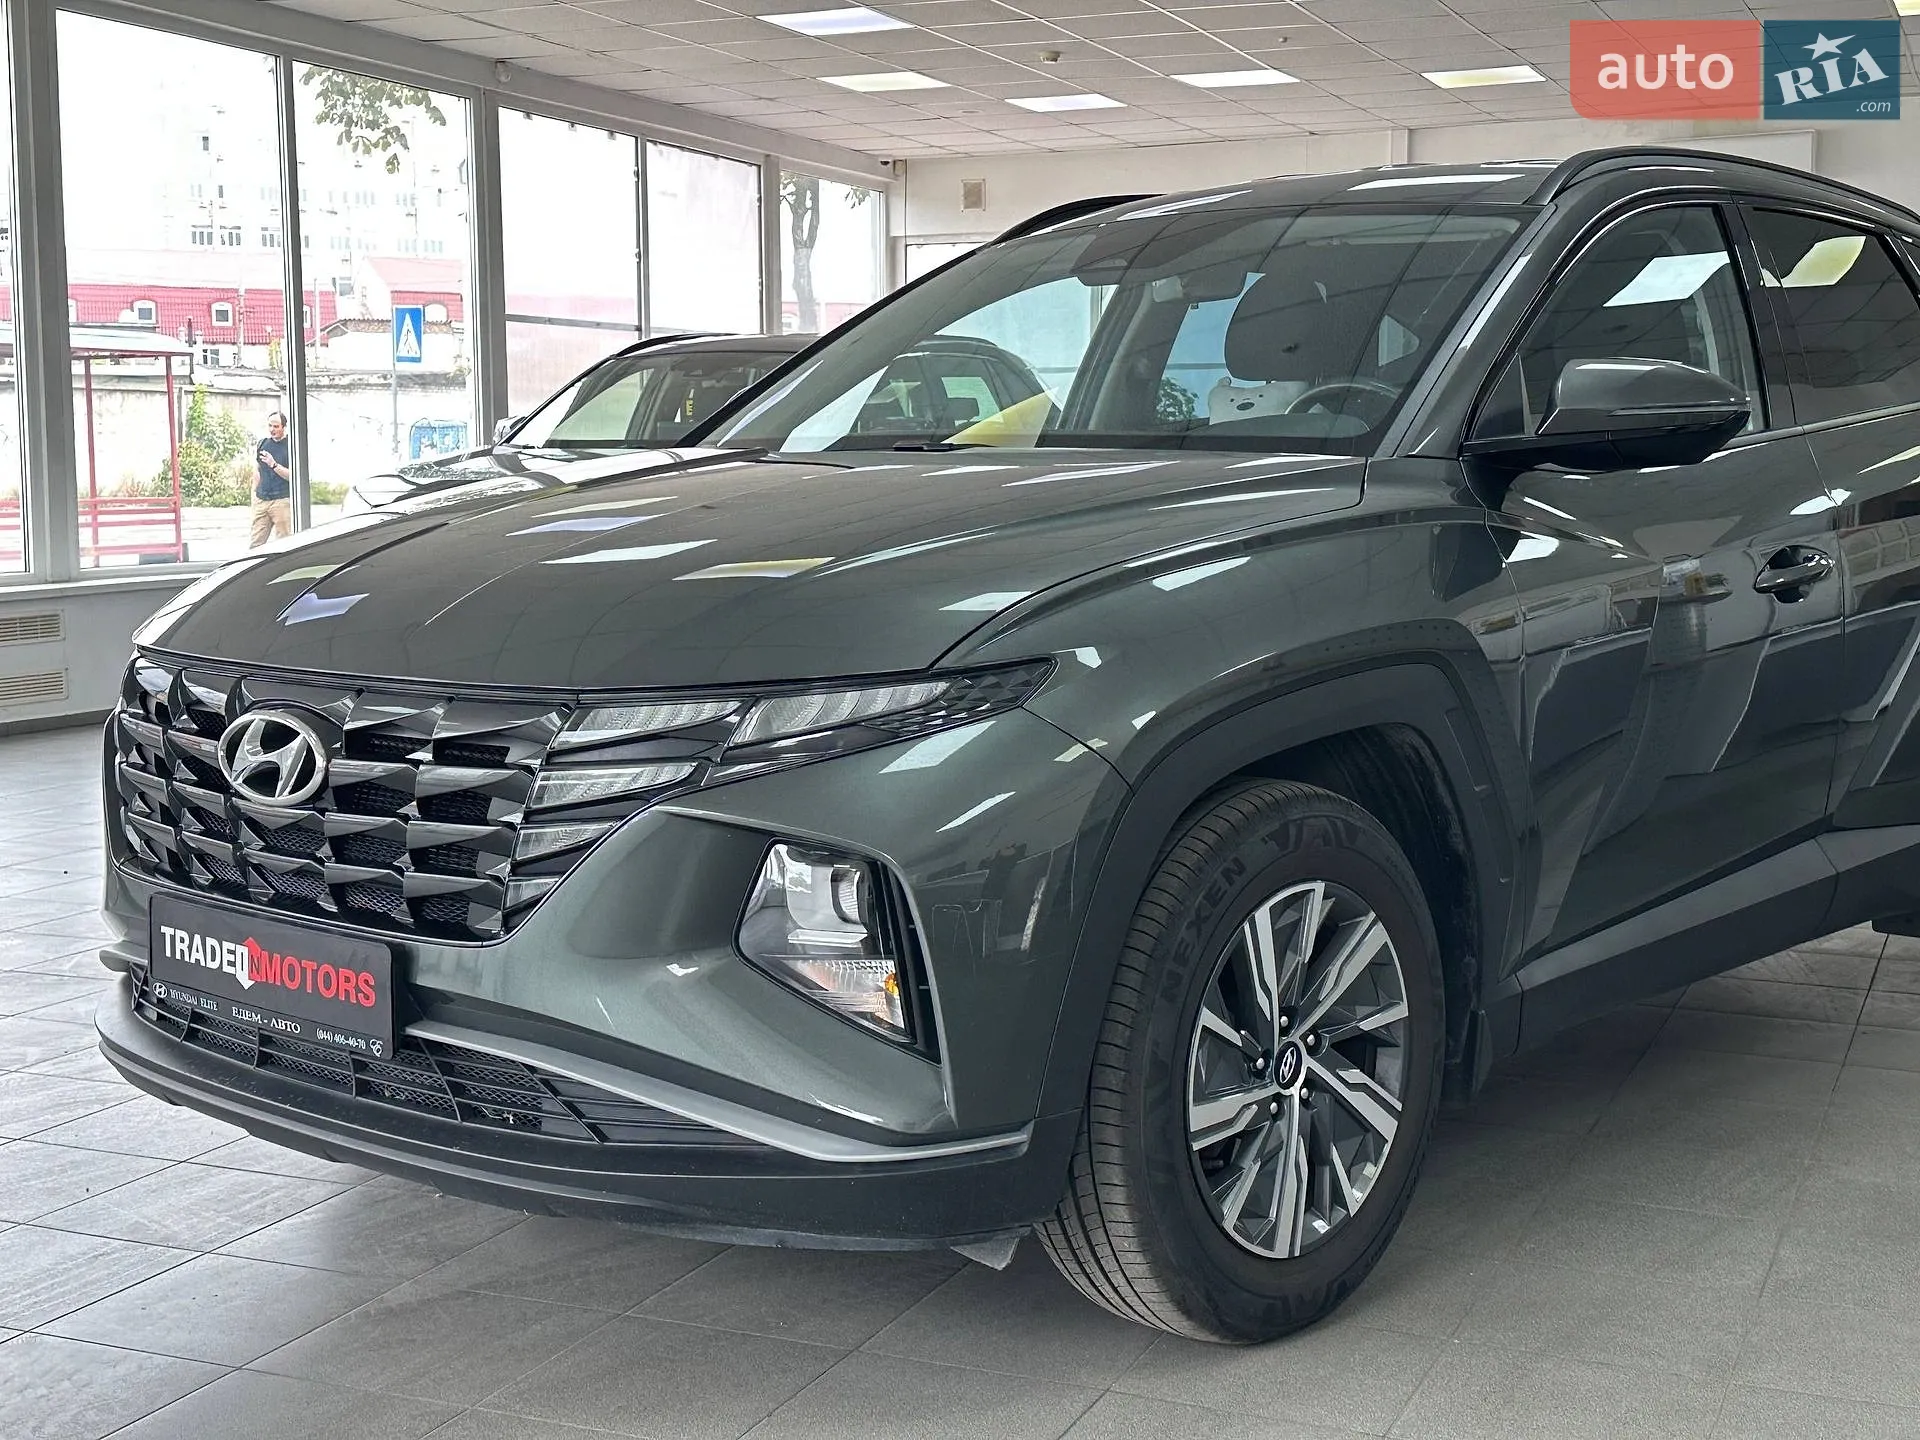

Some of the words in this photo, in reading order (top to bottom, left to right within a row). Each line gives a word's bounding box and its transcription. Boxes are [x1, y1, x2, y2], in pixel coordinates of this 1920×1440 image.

[1159, 856, 1247, 1001] NEXEN
[261, 950, 376, 1007] MOTORS
[170, 989, 198, 1005] HYUNDAI
[200, 998, 218, 1011] ELITE
[316, 1027, 333, 1042] (044)
